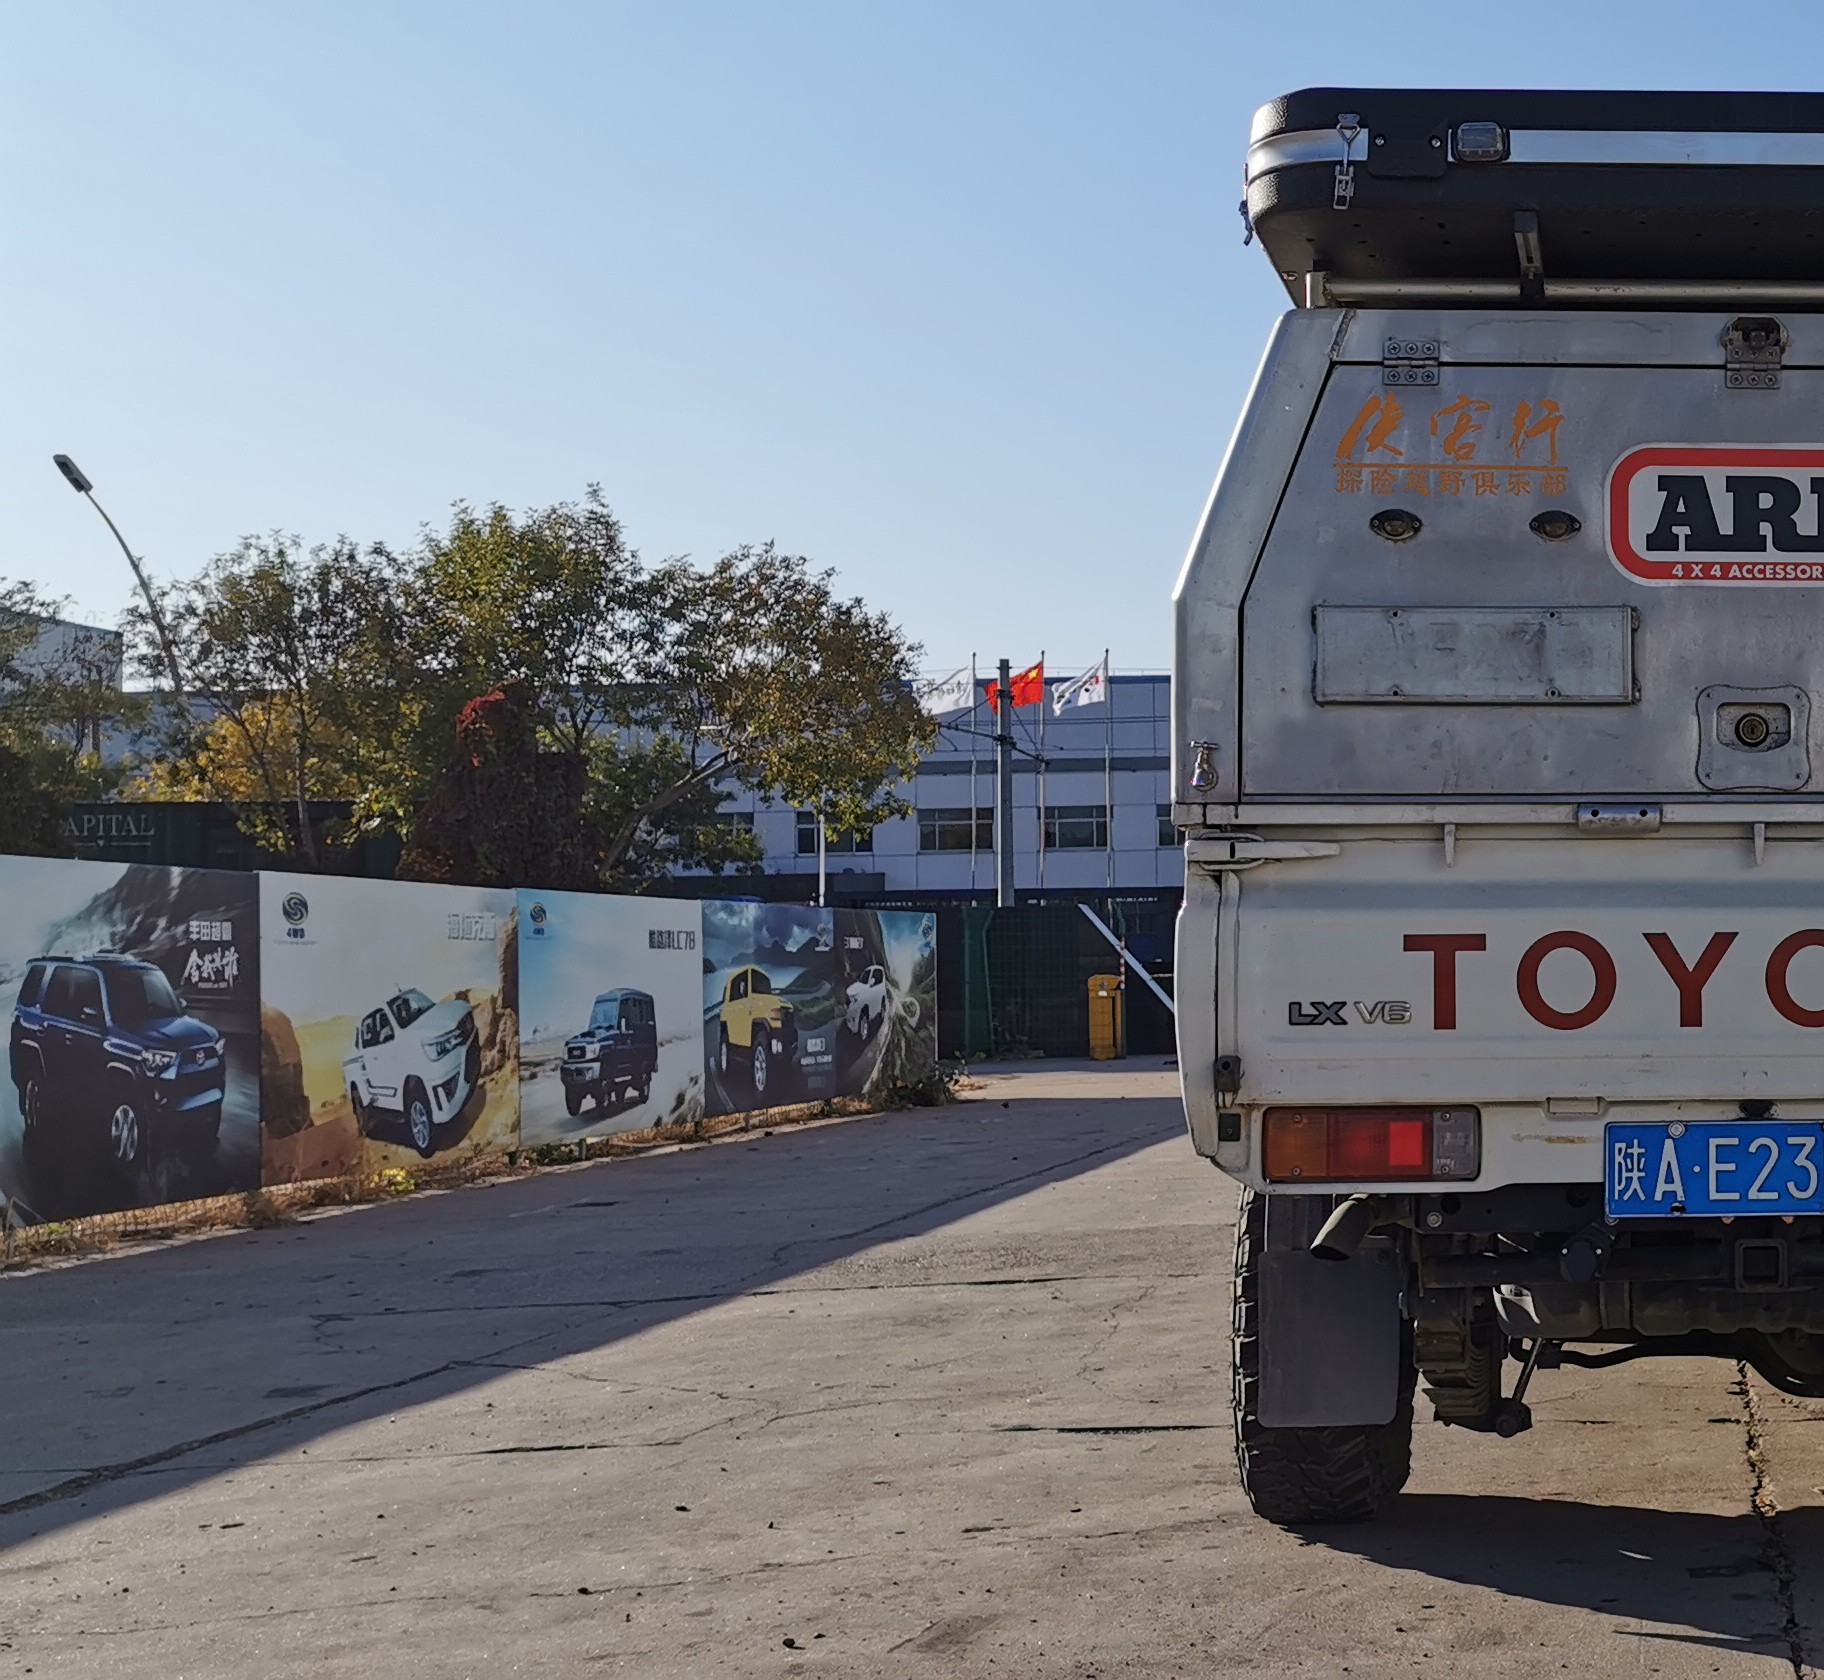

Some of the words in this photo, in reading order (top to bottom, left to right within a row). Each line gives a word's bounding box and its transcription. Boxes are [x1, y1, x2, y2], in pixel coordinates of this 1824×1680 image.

[1335, 468, 1568, 497] 探险越野俱乐部
[60, 814, 155, 836] APITAL
[189, 920, 232, 941] 丰田超
[1288, 1001, 1348, 1026] LX
[1353, 1000, 1412, 1025] V6
